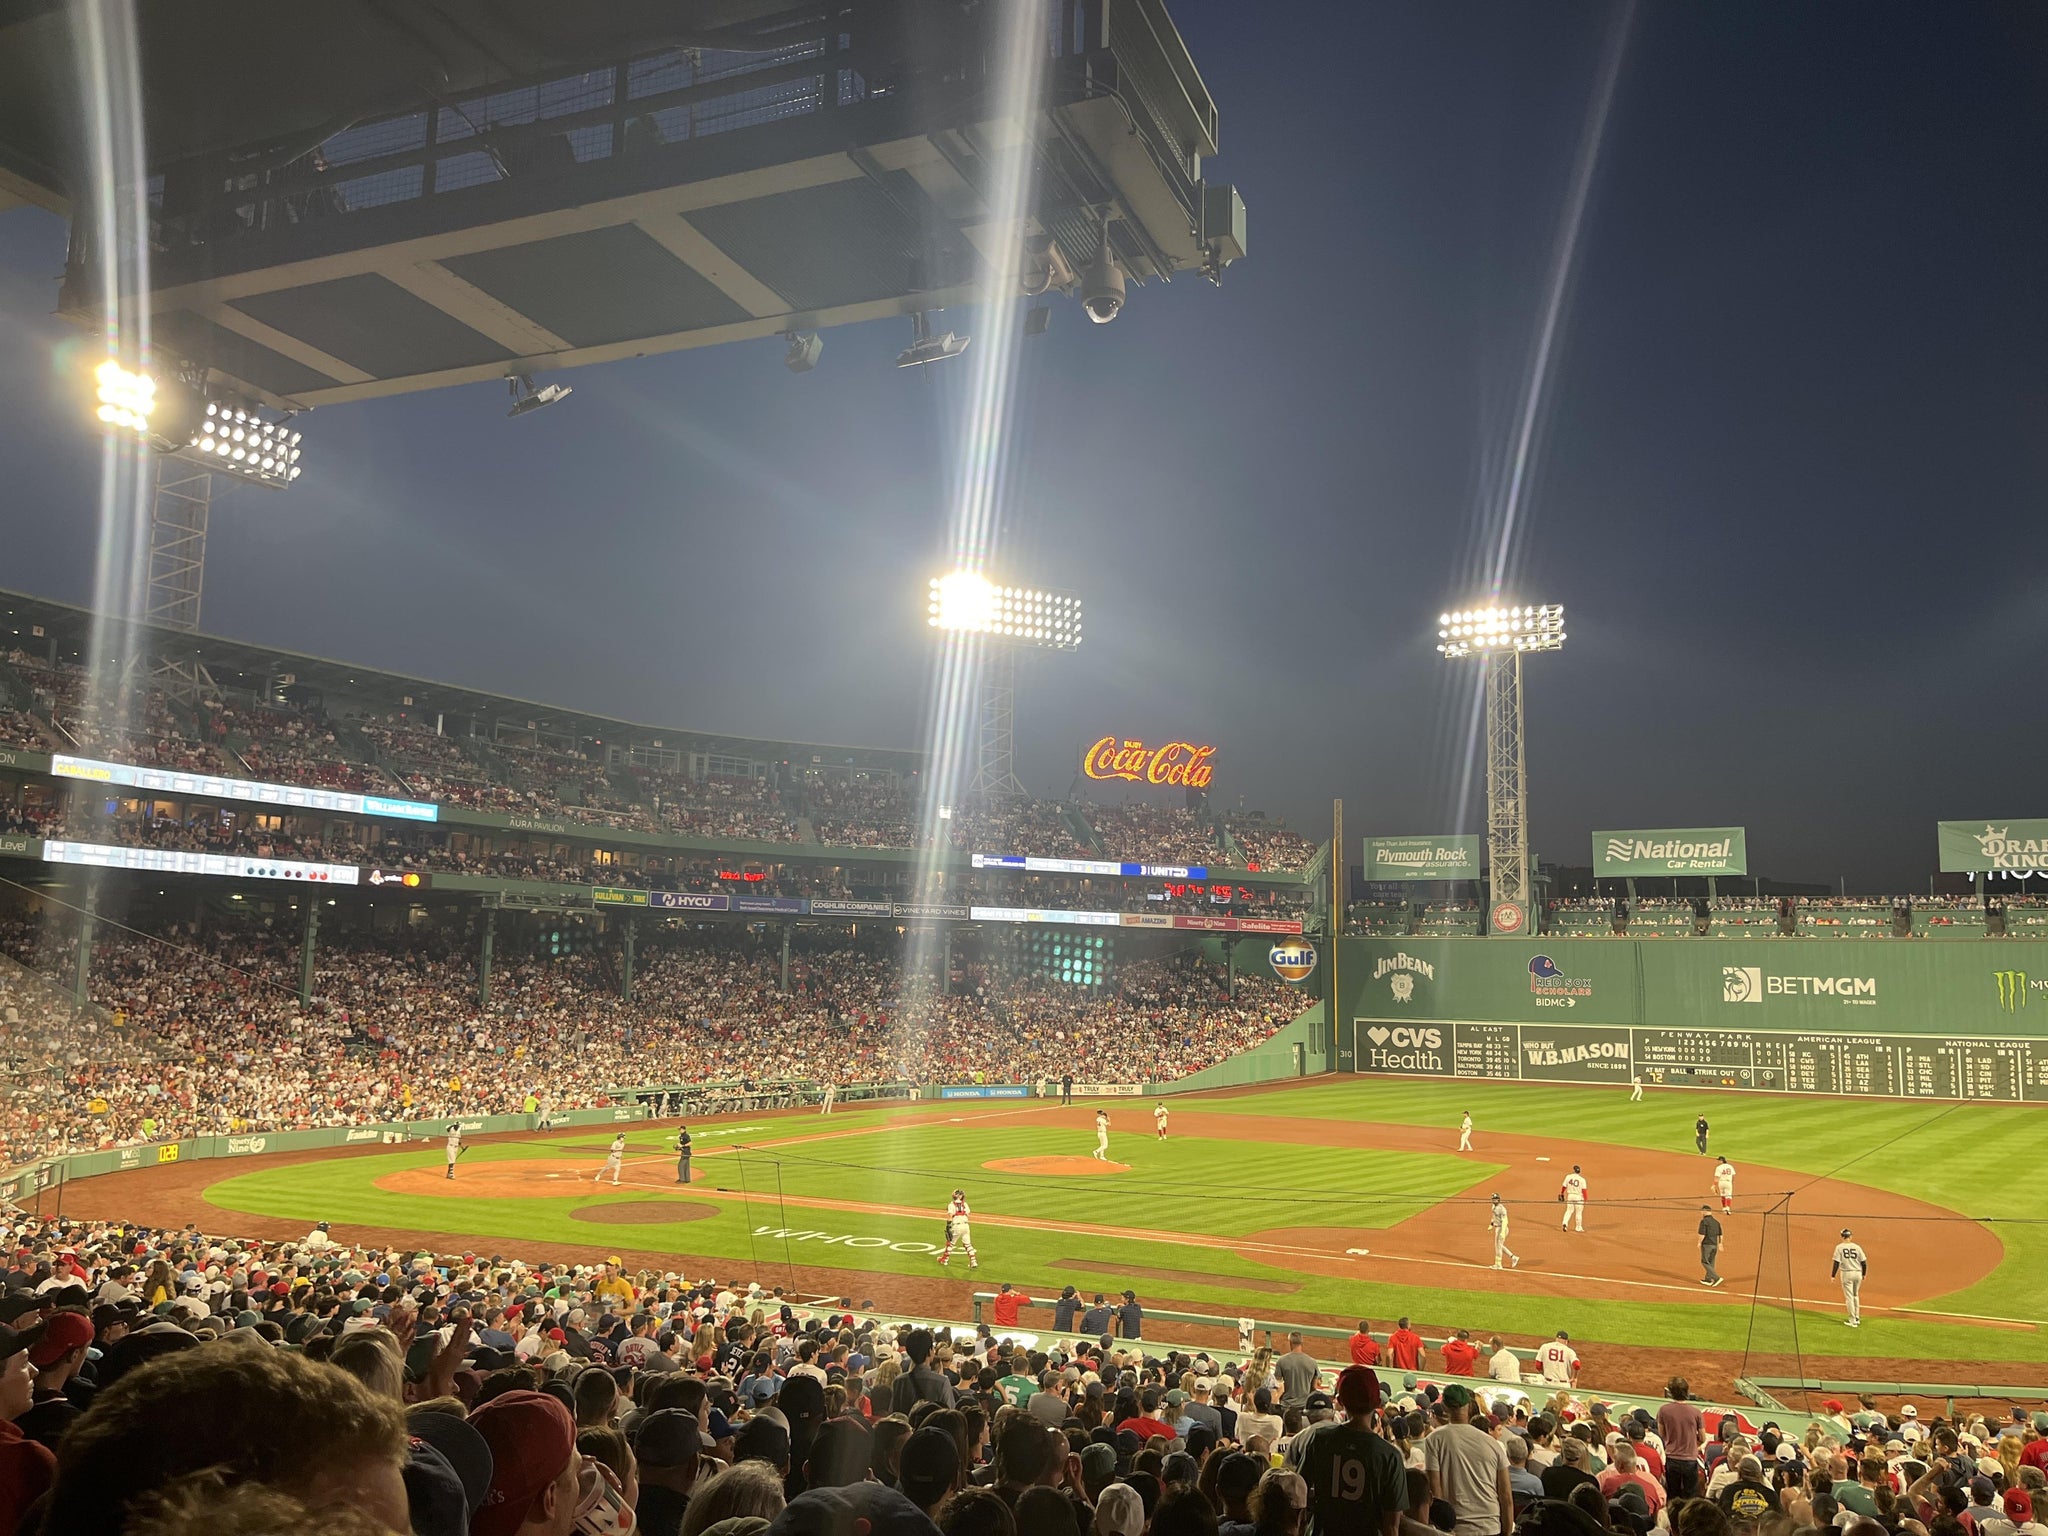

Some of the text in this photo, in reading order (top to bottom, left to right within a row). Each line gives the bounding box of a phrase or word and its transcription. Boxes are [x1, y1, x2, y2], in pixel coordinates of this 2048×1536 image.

[1084, 736, 1216, 787] Coca-Cola
[509, 819, 565, 833] AURA PAVILION
[0, 840, 27, 852] Level
[1376, 847, 1467, 863] Plymouth Rock
[1667, 859, 1726, 869] Car Rental
[1151, 866, 1188, 877] UNITED
[594, 891, 625, 902] SULLIVAN
[678, 896, 712, 907] HYCU
[813, 902, 890, 911] COGHLIN COMPANIES
[903, 907, 941, 915] VINEYARD
[942, 908, 966, 916] VINES
[1241, 922, 1270, 930] Safelite
[1271, 950, 1314, 965] Gulf
[1536, 978, 1592, 987] RED SOX
[1767, 976, 1876, 996] BETMGM
[1535, 987, 1592, 996] SCHOLARS
[1535, 997, 1566, 1007] BIDMC
[1391, 1027, 1442, 1049] CVS
[1661, 1031, 1710, 1039] FENWAY
[1522, 1041, 1554, 1050] WHO BUT
[1340, 1050, 1352, 1058] 310
[1370, 1048, 1443, 1070] Health
[1528, 1042, 1629, 1066] W.B.MASON
[1652, 1053, 1676, 1061] BOSTON
[1586, 1062, 1610, 1070] SINCE
[1670, 1067, 1688, 1075] BALL
[1650, 1072, 1663, 1083] 72
[228, 1145, 250, 1154] Nine
[1568, 1179, 1580, 1187] 40
[752, 1226, 977, 1256] WHOOP
[1842, 1248, 1858, 1260] 85
[625, 1343, 644, 1353] ORTIZ
[1548, 1348, 1564, 1362] 81
[1331, 1454, 1366, 1501] 19
